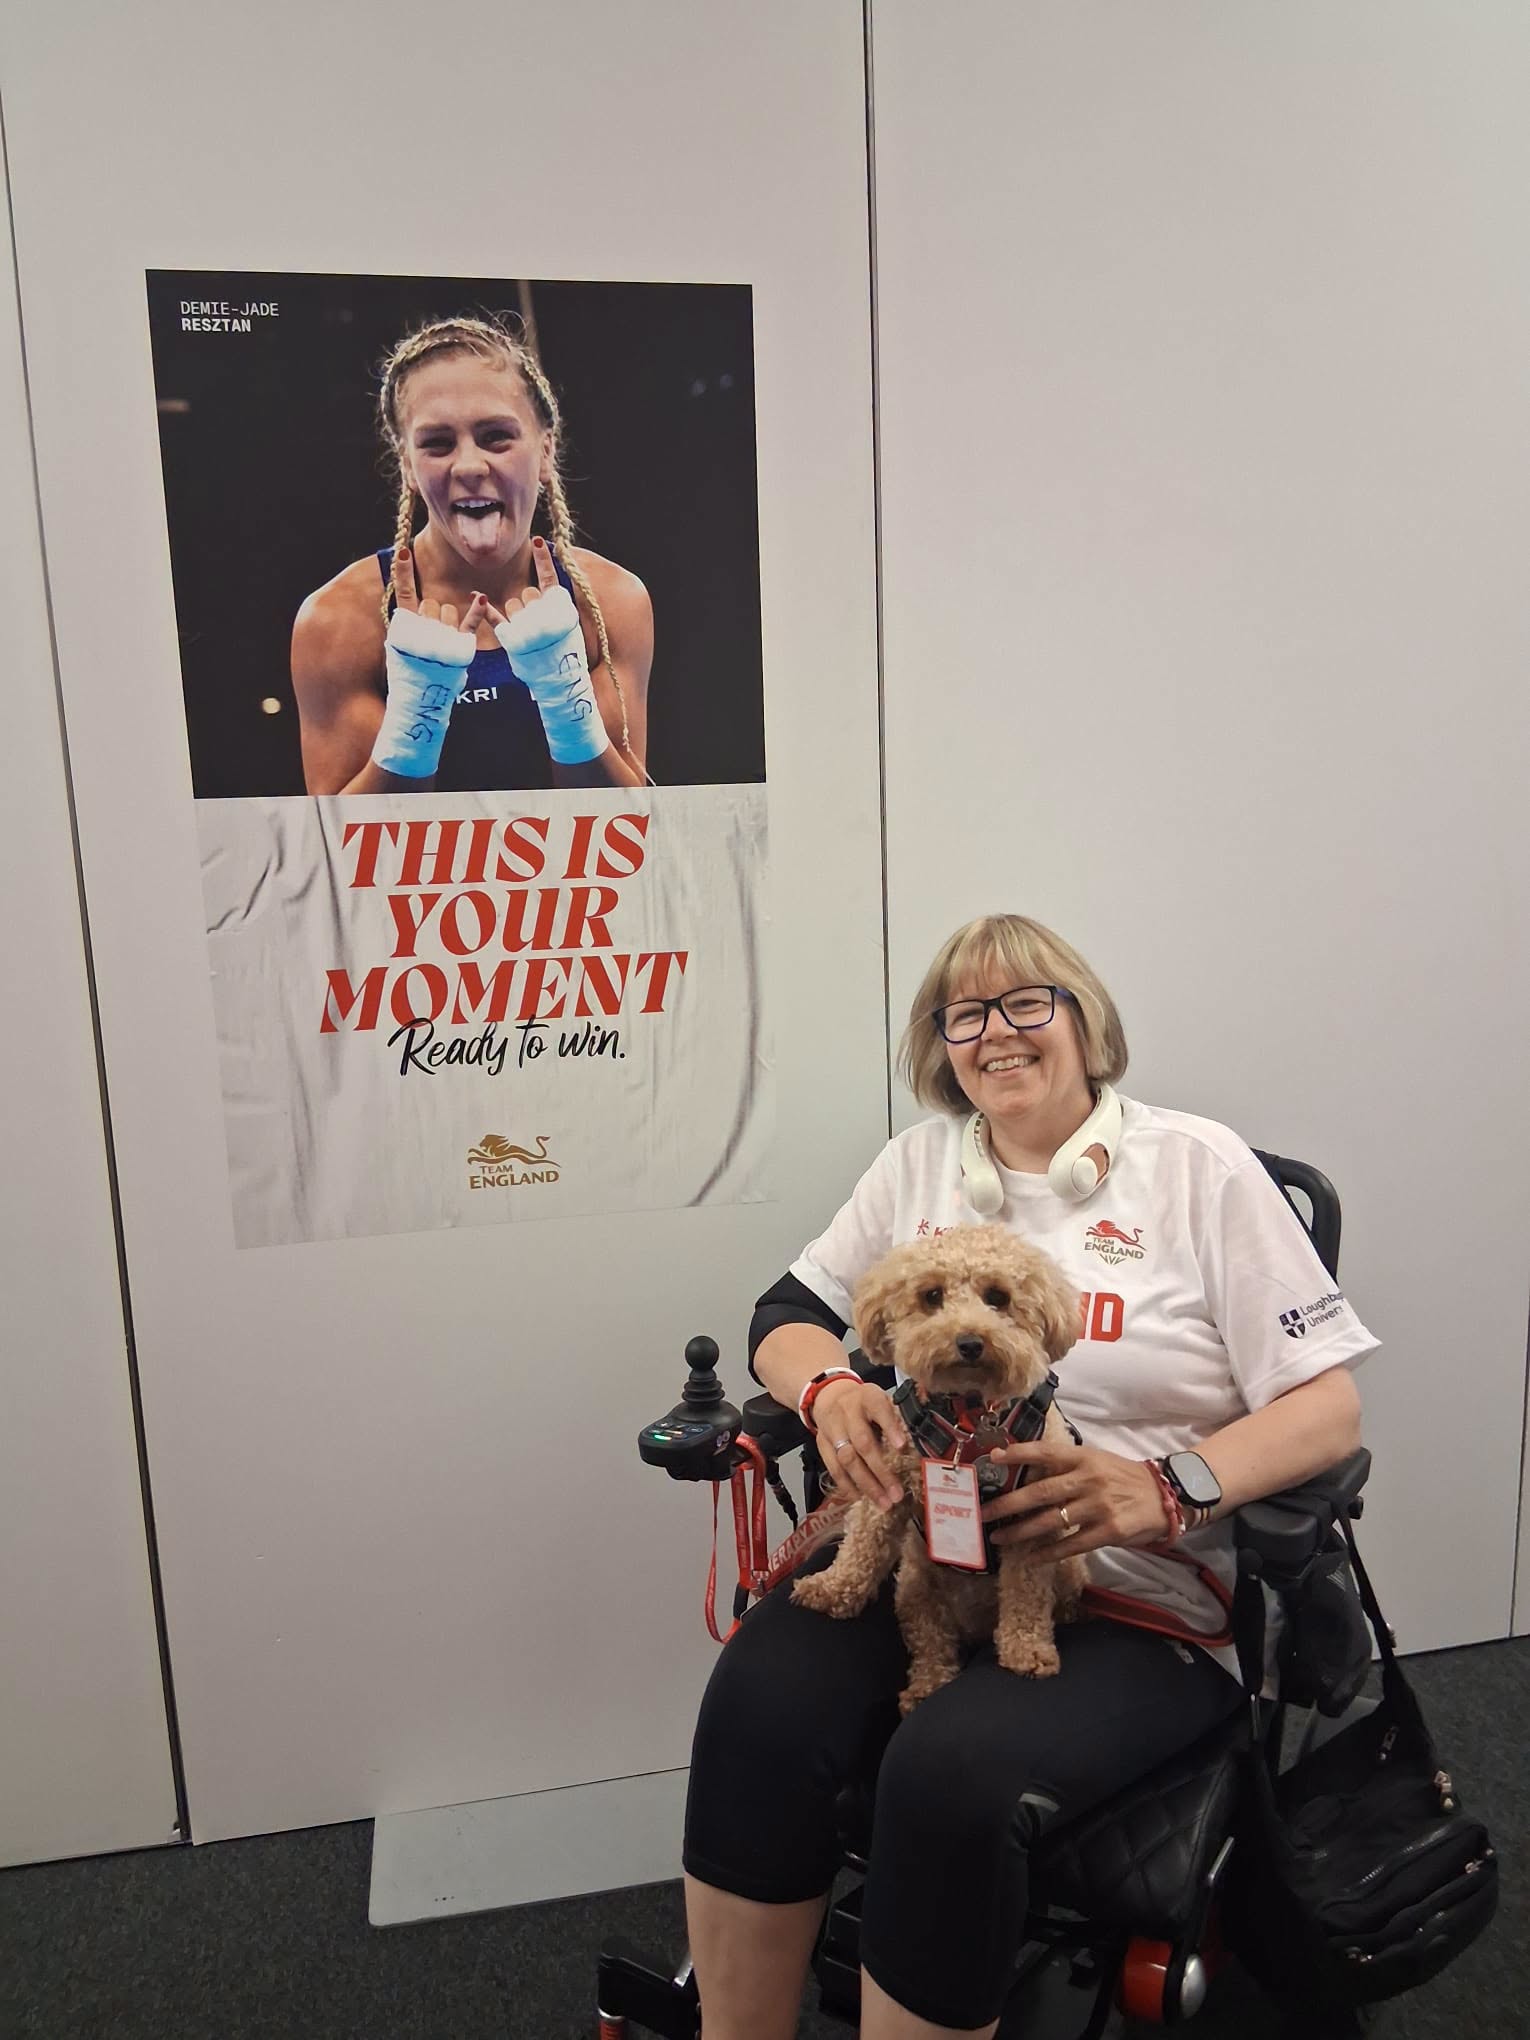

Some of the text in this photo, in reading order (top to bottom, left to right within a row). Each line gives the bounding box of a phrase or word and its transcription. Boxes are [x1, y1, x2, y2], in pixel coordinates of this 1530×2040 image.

[180, 301, 279, 317] DEMIE-JADE
[181, 318, 251, 332] RESZTAN
[557, 651, 593, 722] ENG
[404, 684, 452, 744] ENG
[341, 813, 650, 889] THIS IS
[387, 886, 619, 958] YOUR
[319, 951, 689, 1034] MOMENT
[387, 1013, 626, 1077] Ready to win.
[469, 1170, 560, 1190] ENGLAND
[479, 1165, 514, 1175] TEAM
[1084, 1241, 1145, 1260] ENGLAND
[1093, 1237, 1115, 1246] TEAM
